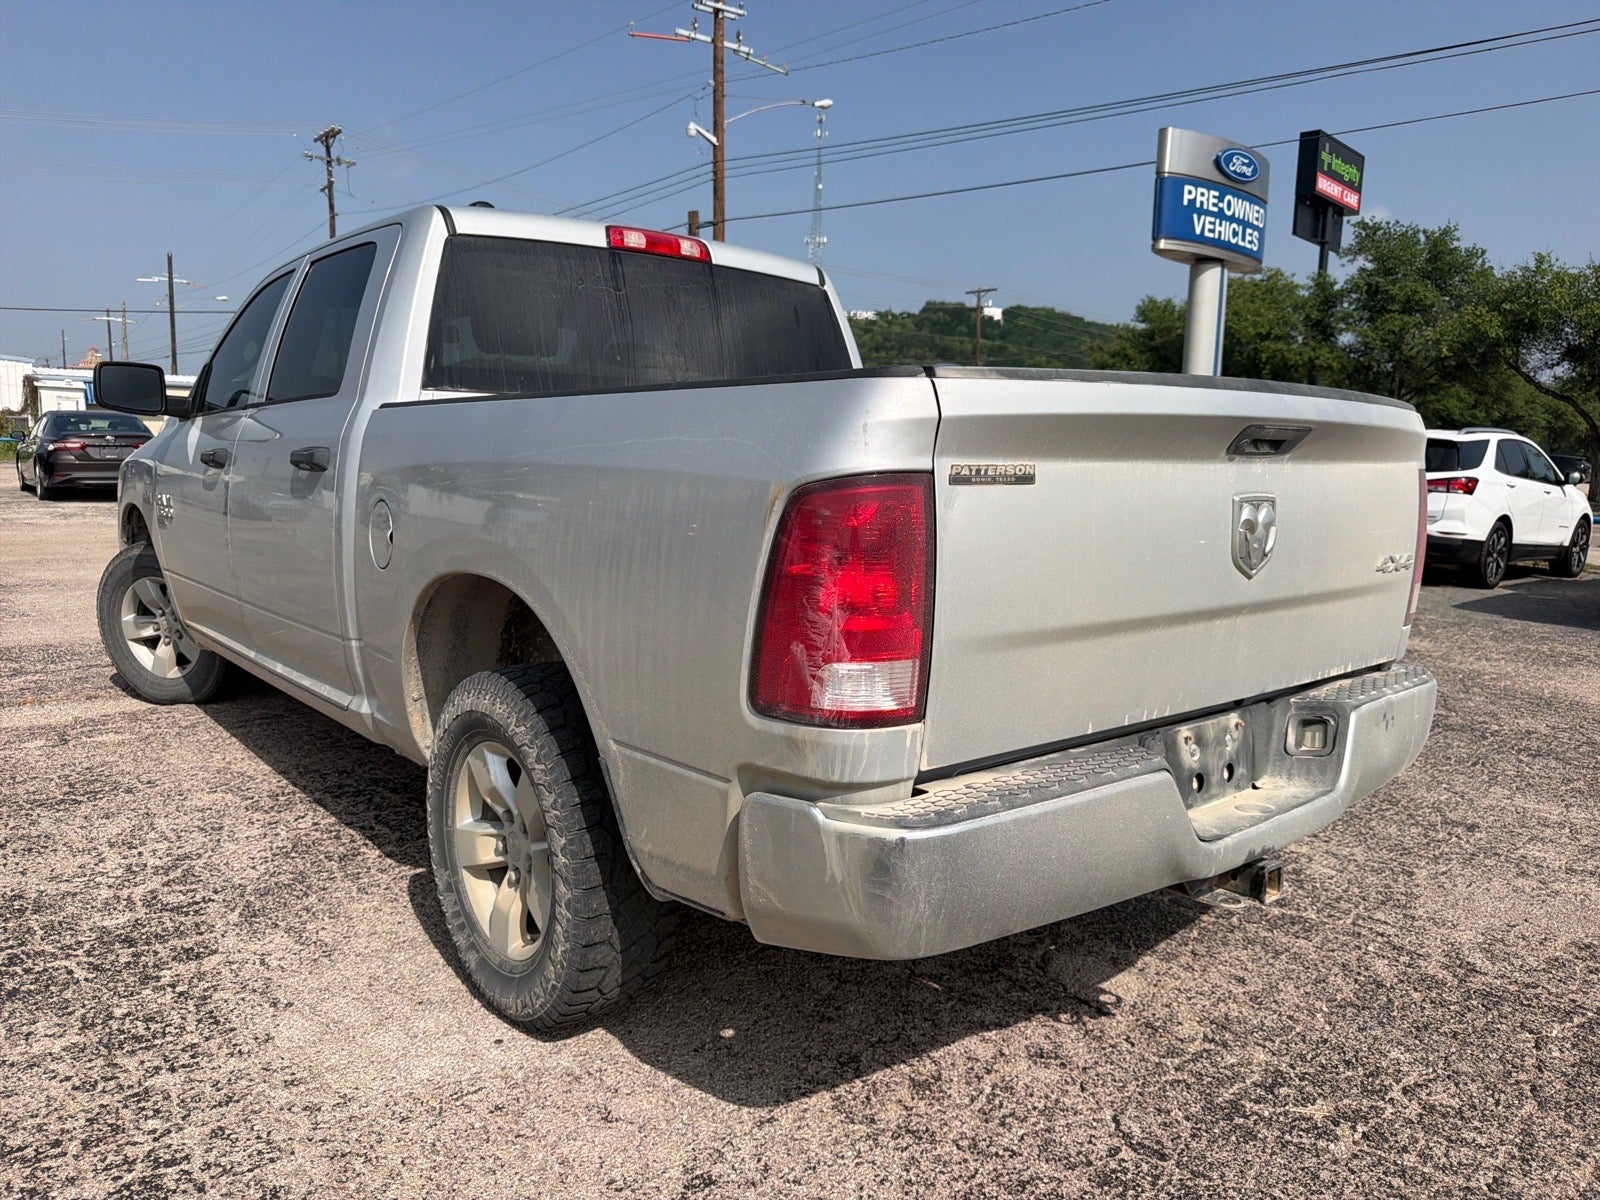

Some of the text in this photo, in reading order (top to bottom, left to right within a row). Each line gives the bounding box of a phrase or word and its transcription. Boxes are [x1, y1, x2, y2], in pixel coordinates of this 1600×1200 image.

[1229, 155, 1254, 176] Ford
[1332, 153, 1360, 186] Integrity
[1183, 184, 1265, 228] PRE-OWNED
[1318, 176, 1359, 207] URGENT CARE
[1192, 213, 1260, 251] VEHICLES
[951, 465, 1035, 475] PATTERSON
